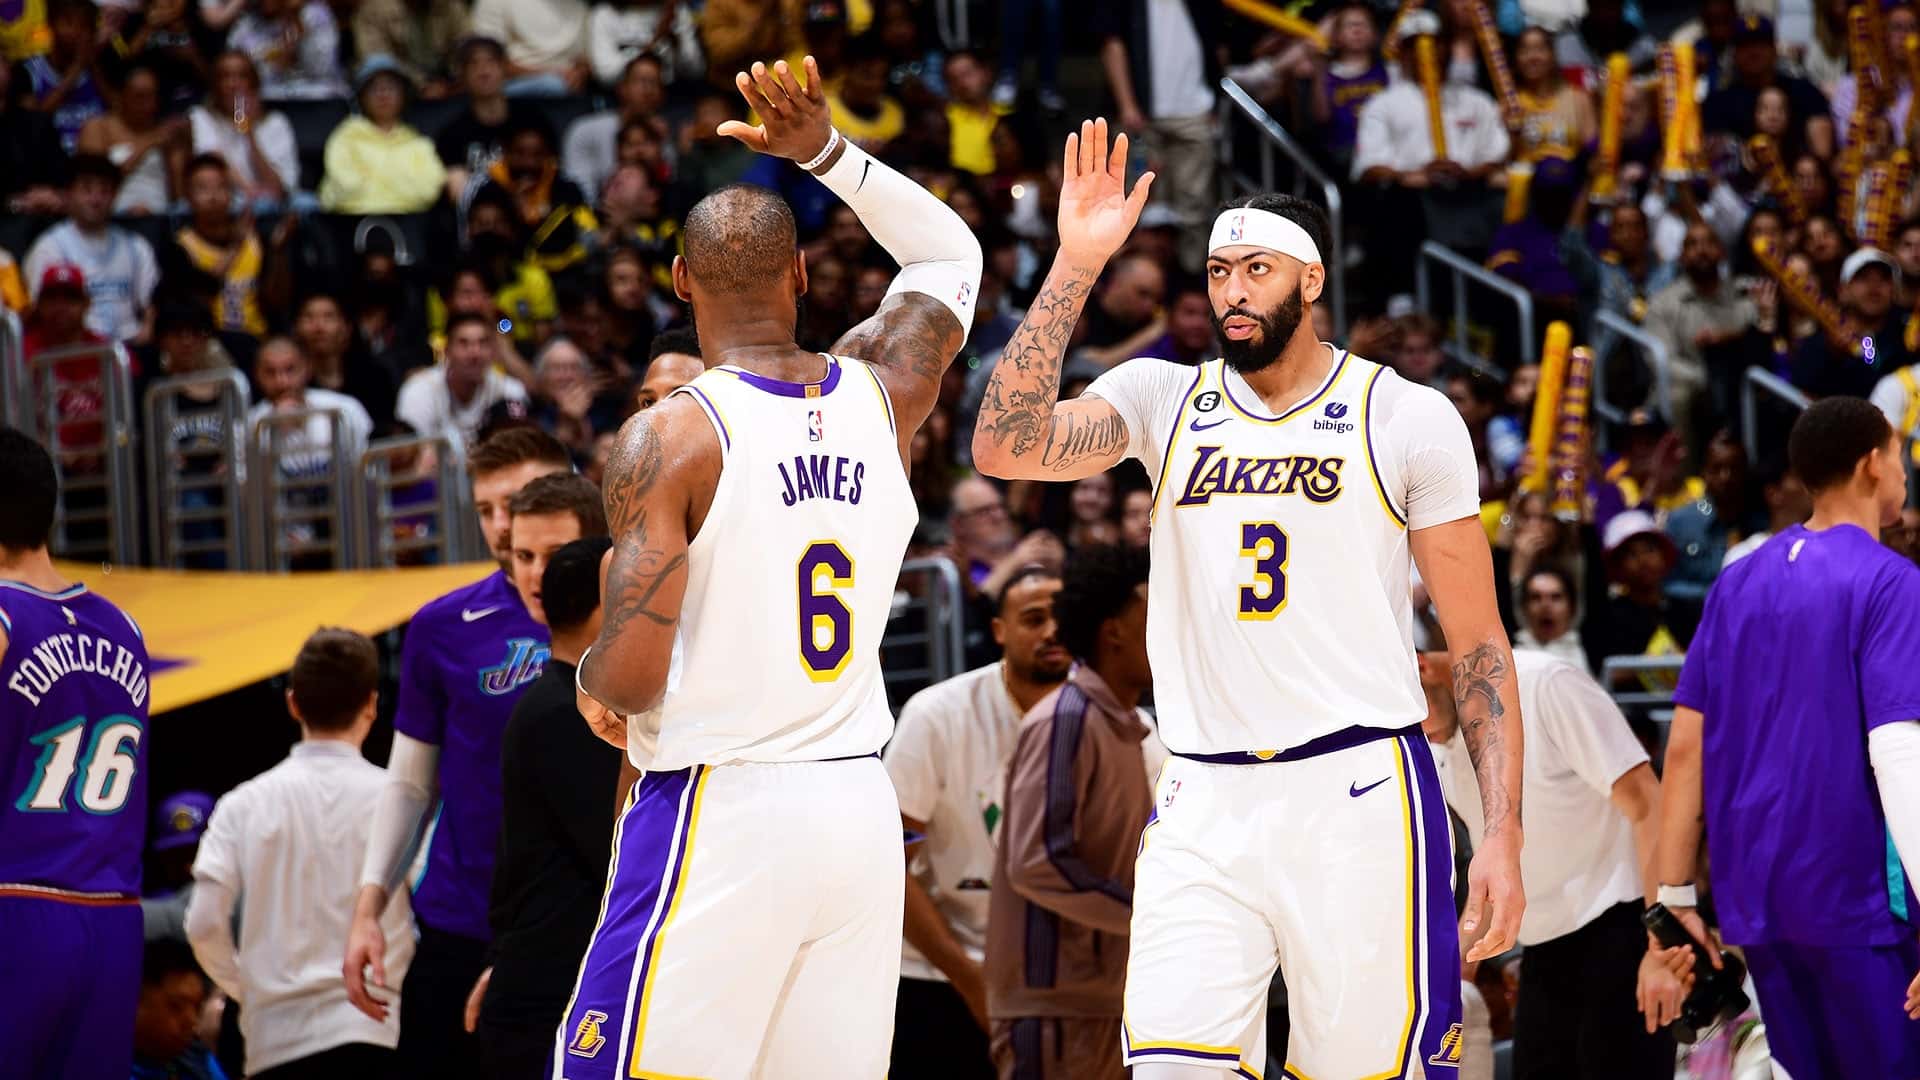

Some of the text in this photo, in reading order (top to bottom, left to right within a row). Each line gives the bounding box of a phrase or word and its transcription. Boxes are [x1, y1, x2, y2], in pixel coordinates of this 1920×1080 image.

[1198, 393, 1216, 411] 6
[1313, 420, 1354, 434] bibigo
[778, 455, 866, 506] JAMES
[1175, 445, 1346, 508] LAKERS
[1238, 520, 1290, 621] 3
[796, 539, 855, 683] 6
[8, 633, 148, 707] FONTECCHIO
[15, 714, 143, 814] 16
